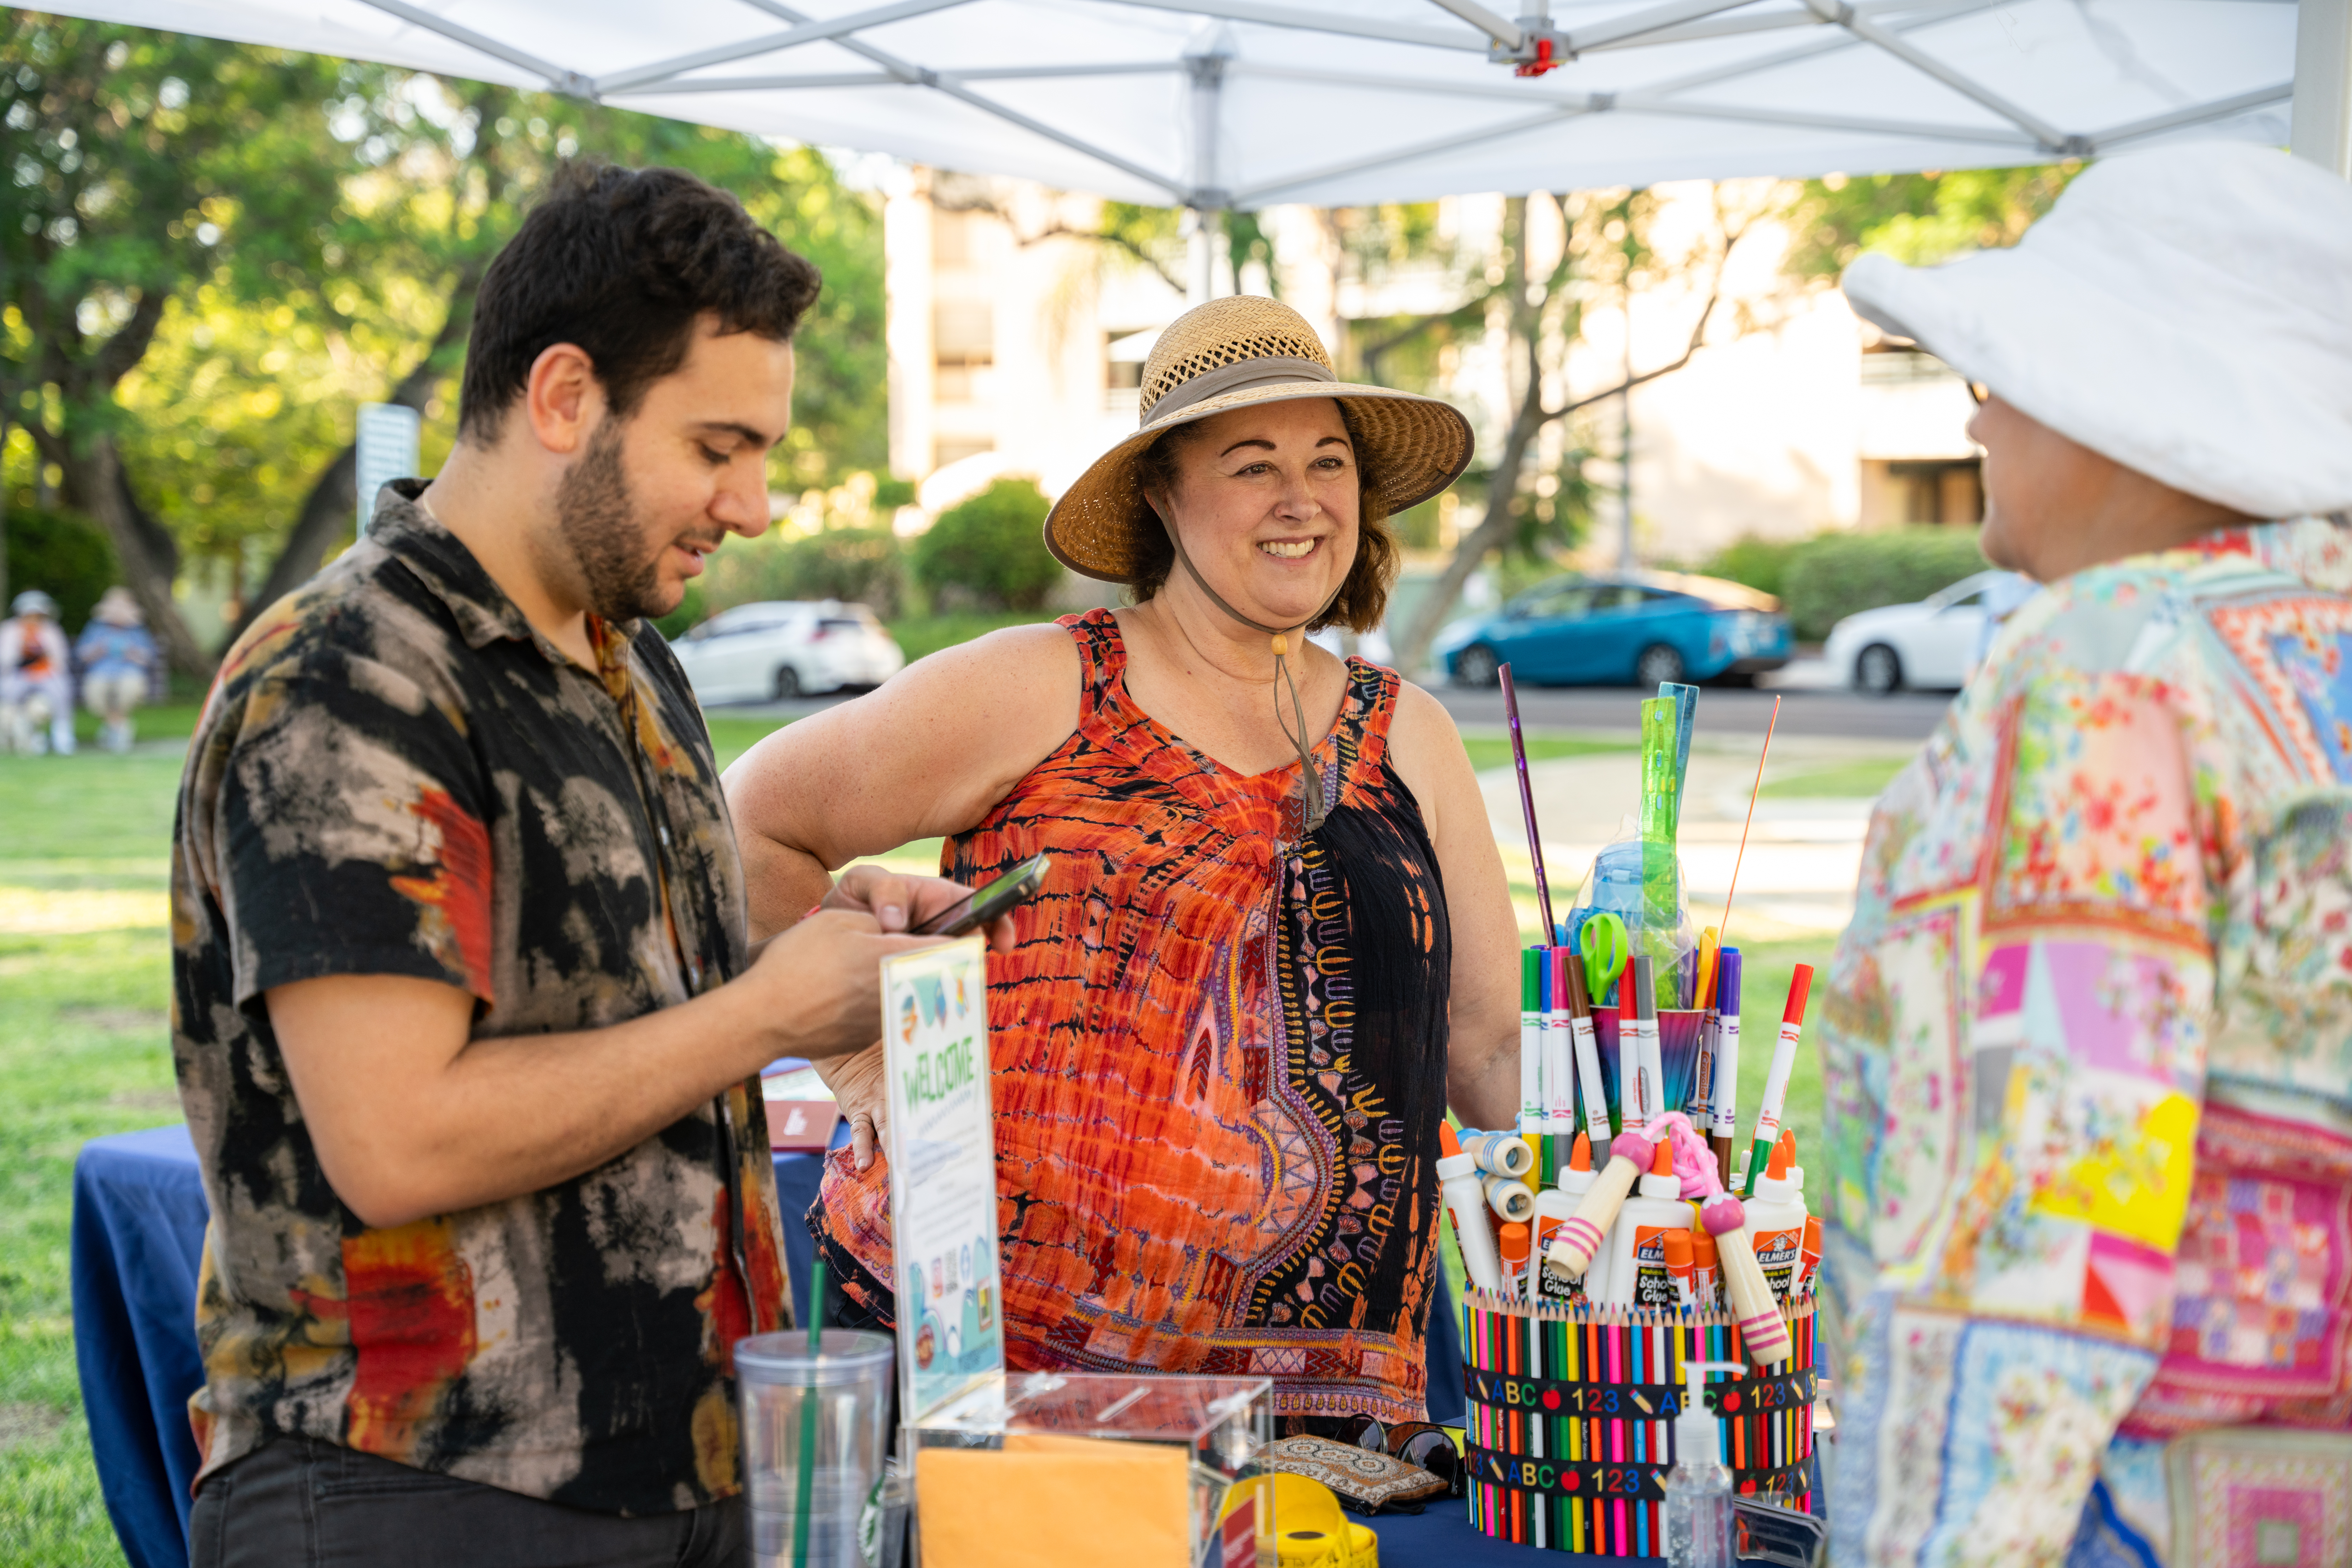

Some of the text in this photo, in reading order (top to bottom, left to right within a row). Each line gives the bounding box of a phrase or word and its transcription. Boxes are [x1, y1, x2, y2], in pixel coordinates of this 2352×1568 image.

[903, 1036, 974, 1114] WELCOME
[1700, 1054, 1709, 1094] Crayola
[1758, 1249, 1796, 1262] ELMER'S
[1545, 1279, 1571, 1296] Glue
[1639, 1275, 1668, 1290] Scho
[1768, 1274, 1791, 1290] hool
[1642, 1288, 1668, 1303] Glue
[1492, 1380, 1619, 1413] ABC 123
[1751, 1382, 1786, 1409] 123
[1467, 1450, 1483, 1476] 123
[1508, 1461, 1640, 1493] ABC 123
[1766, 1472, 1794, 1497] 123
